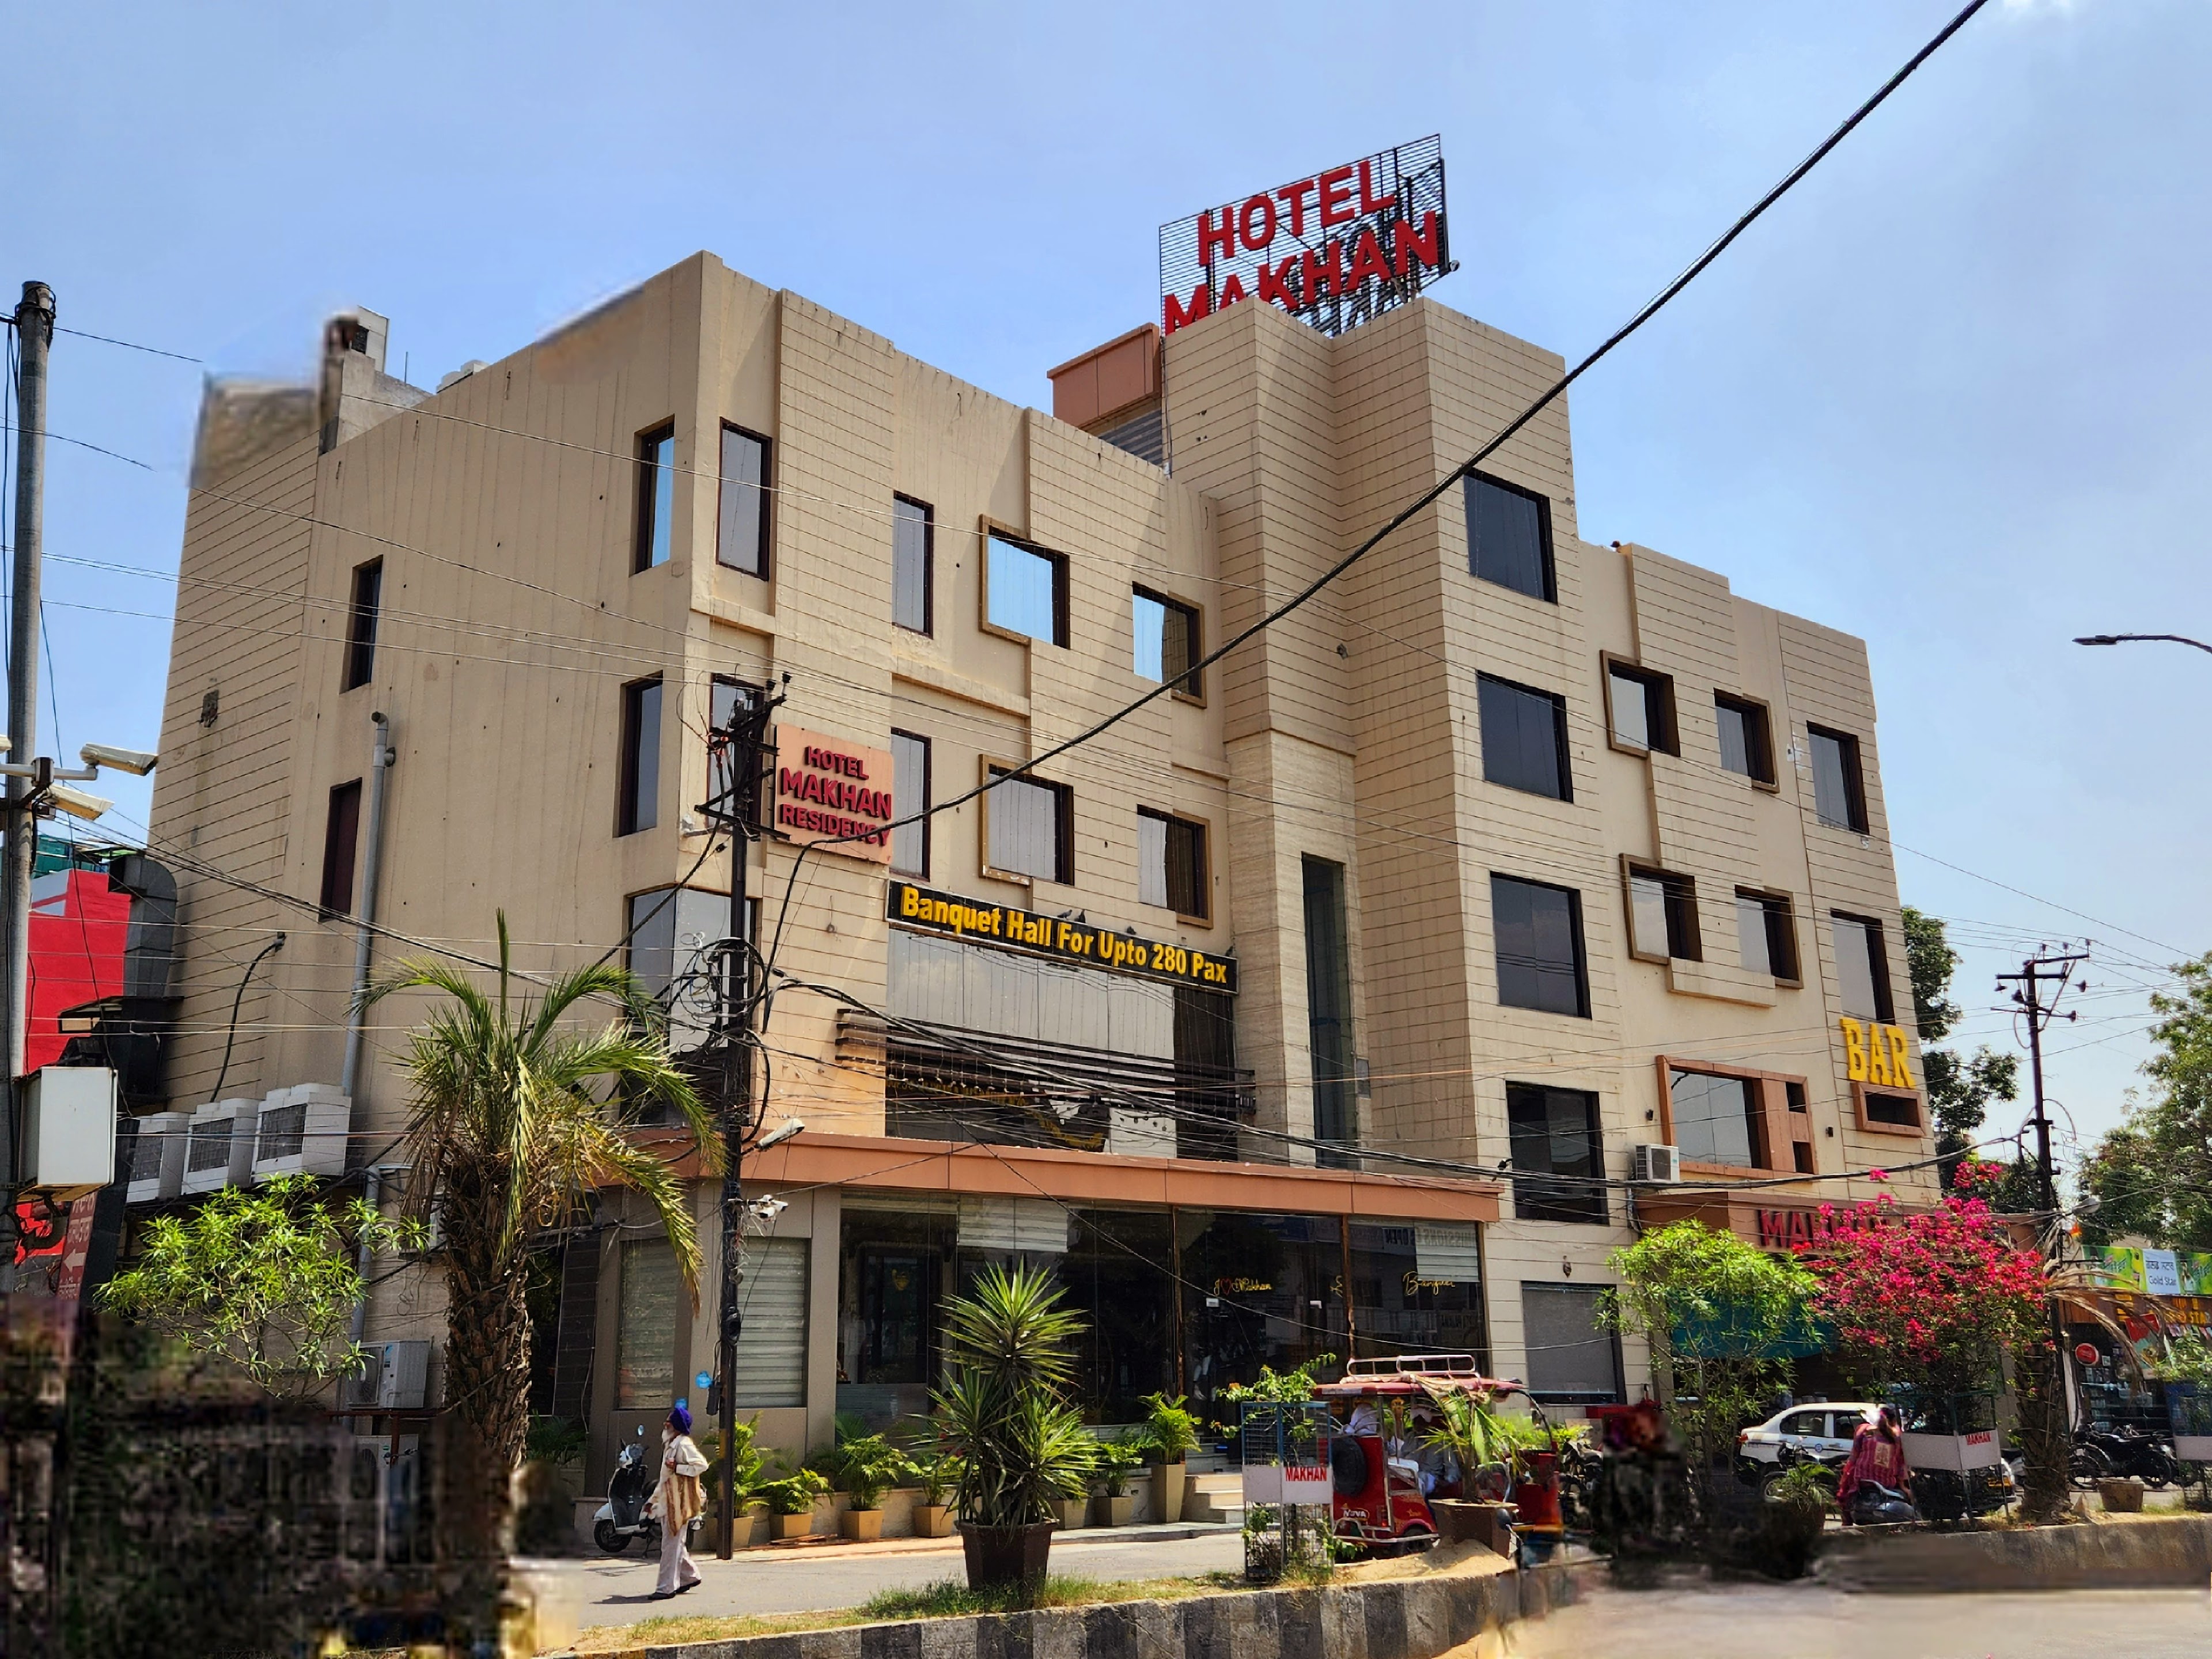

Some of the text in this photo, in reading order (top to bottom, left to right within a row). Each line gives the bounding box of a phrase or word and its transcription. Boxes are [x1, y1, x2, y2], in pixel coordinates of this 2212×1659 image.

[1198, 160, 1395, 266] HOTEL
[805, 746, 869, 780] HOTEL
[781, 767, 892, 820] MAKHAN
[780, 804, 891, 847] RESIDENCY
[901, 885, 1228, 983] Banquet Hall For Upto 280 Pax
[1839, 1017, 1916, 1089] BAR
[1286, 1467, 1327, 1482] MAKHAN
